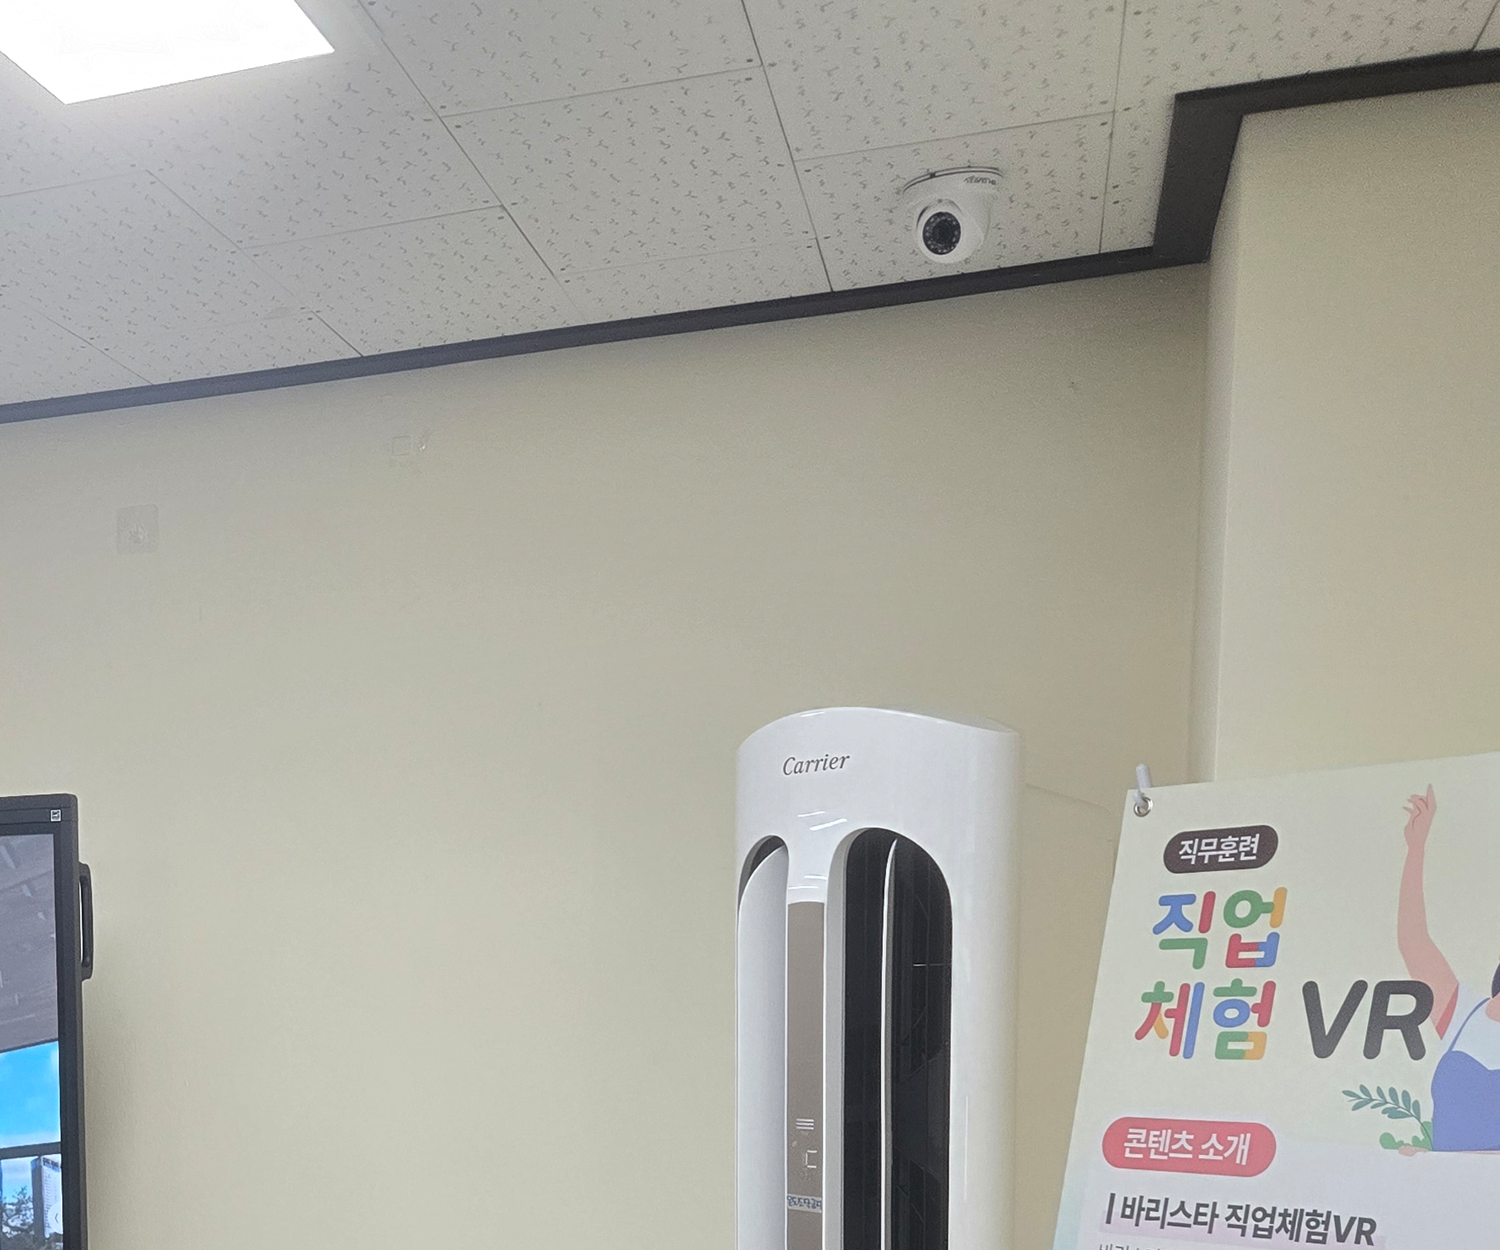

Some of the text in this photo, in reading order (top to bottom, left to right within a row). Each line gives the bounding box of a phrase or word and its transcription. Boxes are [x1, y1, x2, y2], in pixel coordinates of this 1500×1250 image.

[783, 754, 850, 776] Carrier
[1178, 834, 1260, 865] 직무훈련
[1152, 886, 1288, 970] 직업
[1134, 978, 1435, 1061] 체험 VR
[1123, 1127, 1251, 1165] 콘텐츠 소개
[1120, 1195, 1377, 1246] 바리스타 직업체험VR
